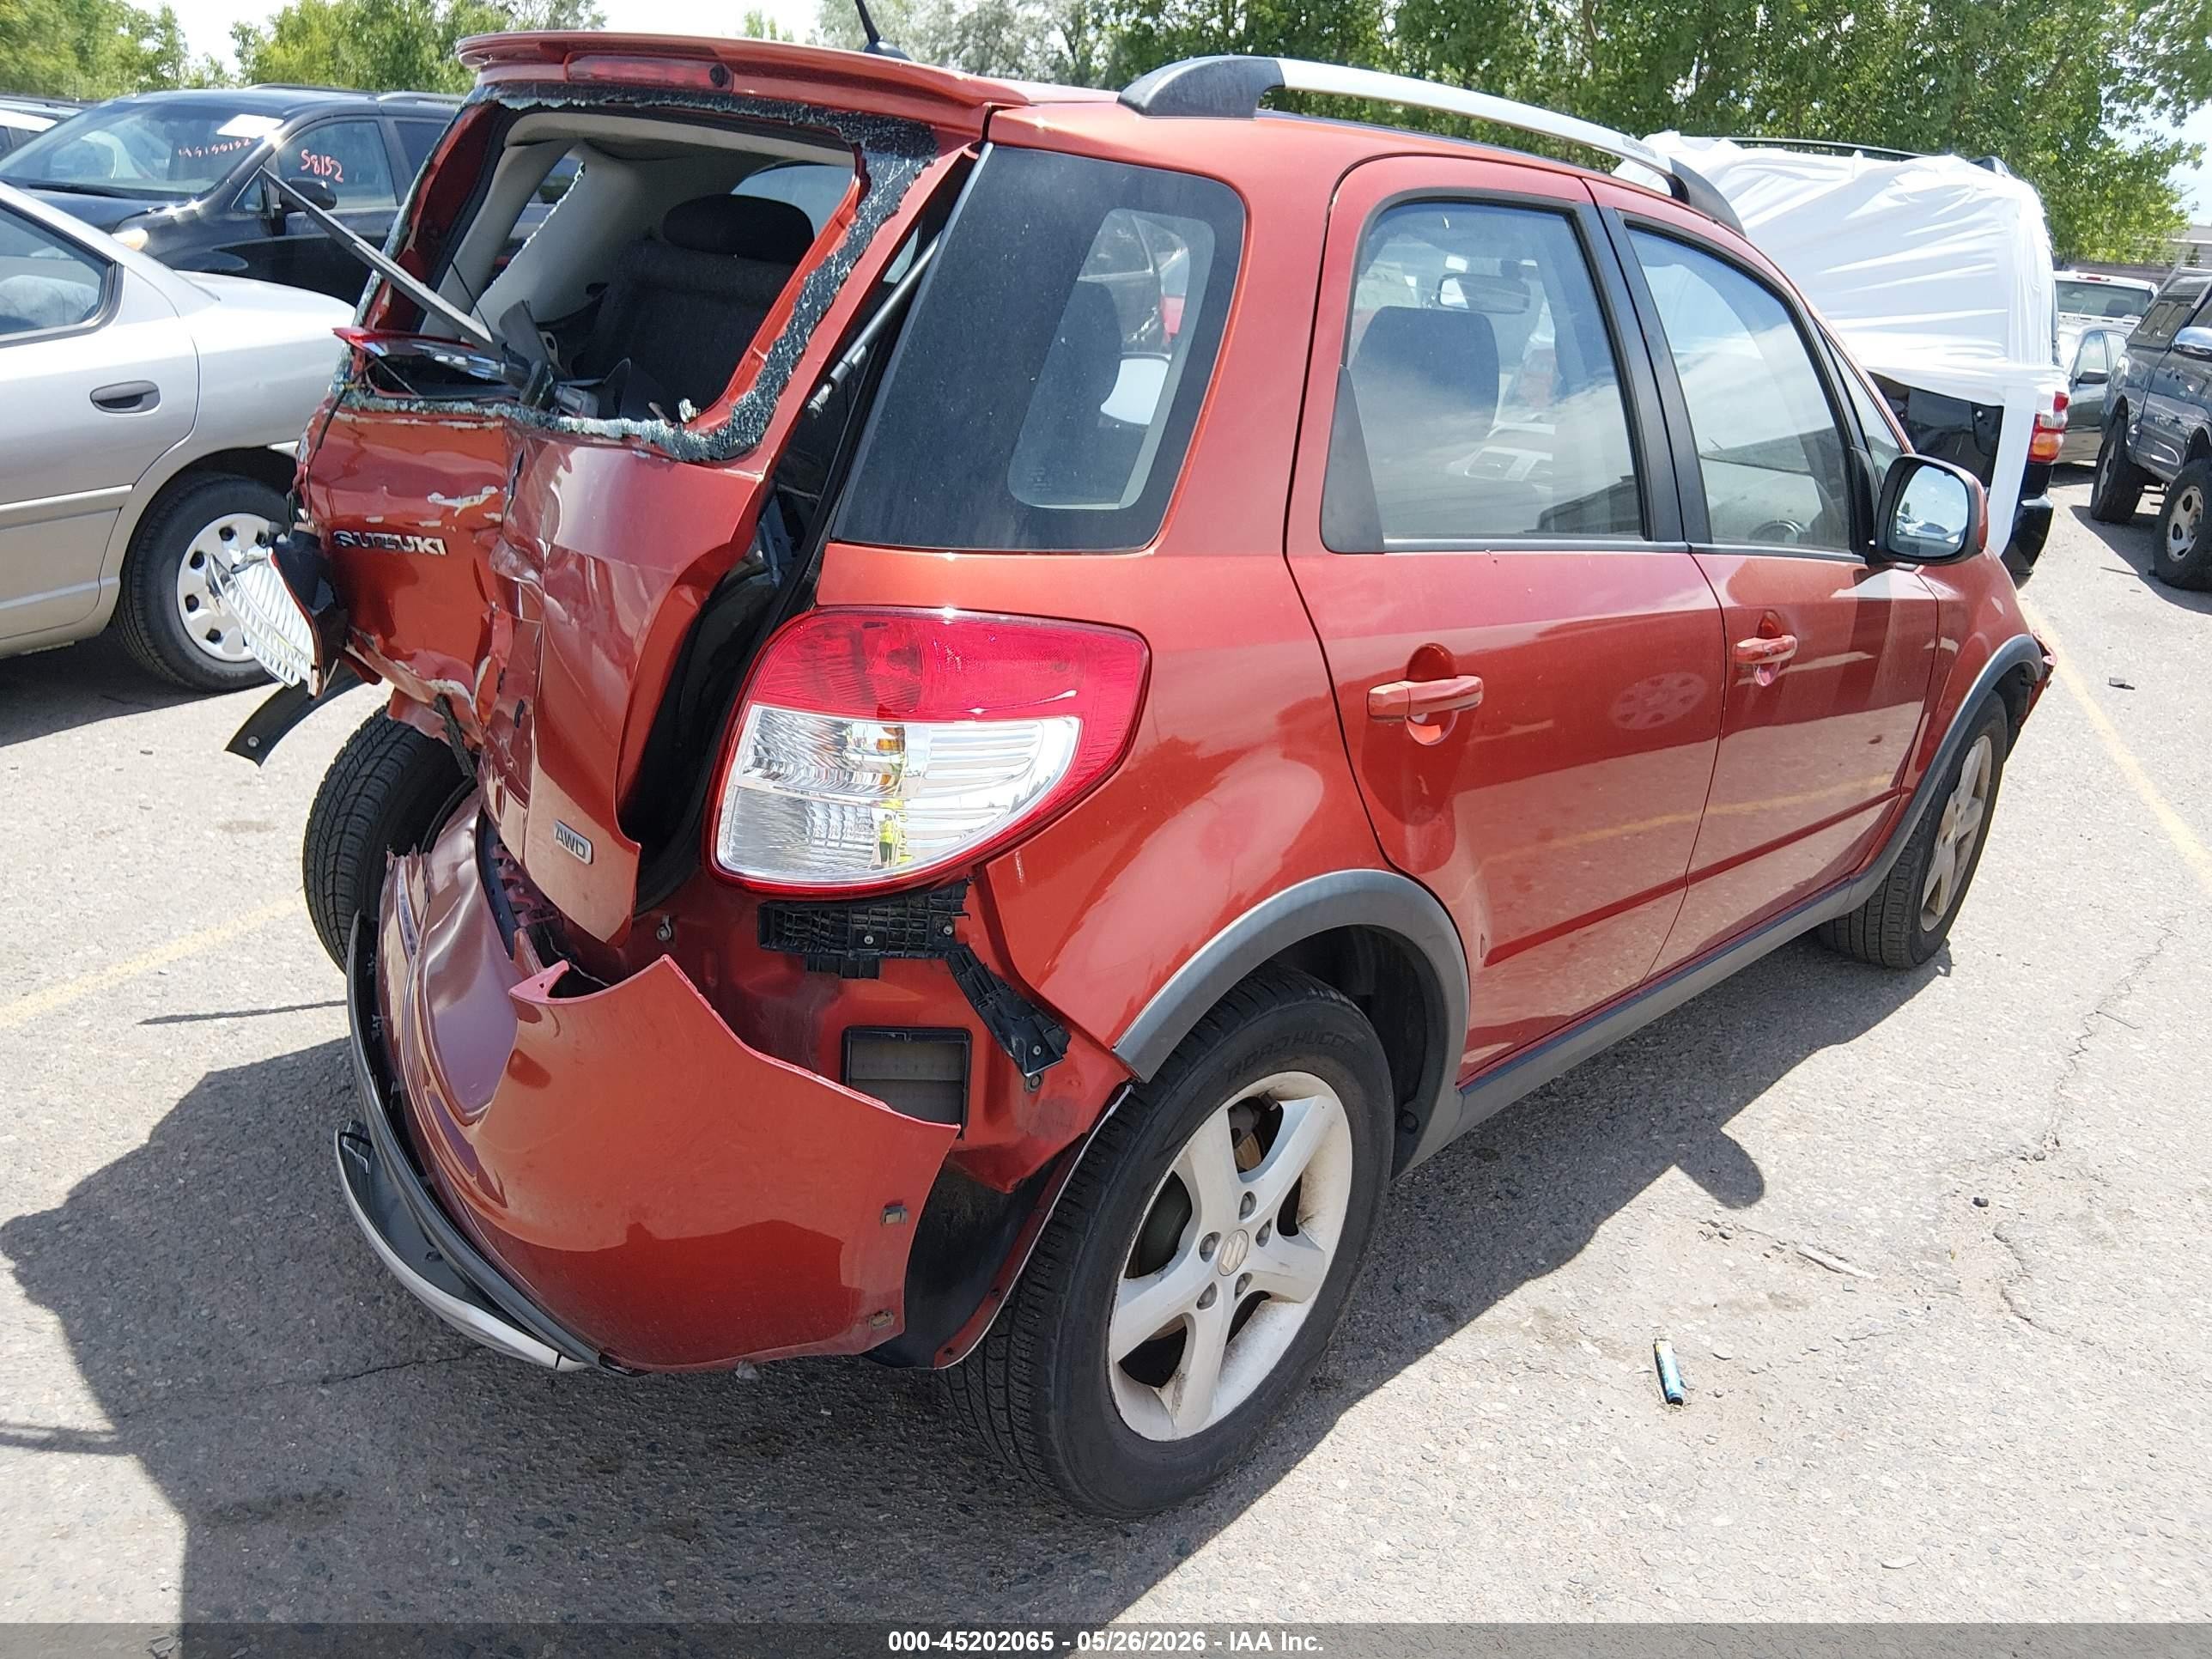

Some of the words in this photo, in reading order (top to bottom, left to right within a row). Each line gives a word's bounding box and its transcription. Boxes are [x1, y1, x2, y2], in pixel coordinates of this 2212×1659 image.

[301, 149, 343, 183] 58152
[333, 530, 447, 556] SUZUKI
[556, 827, 586, 860] AWD
